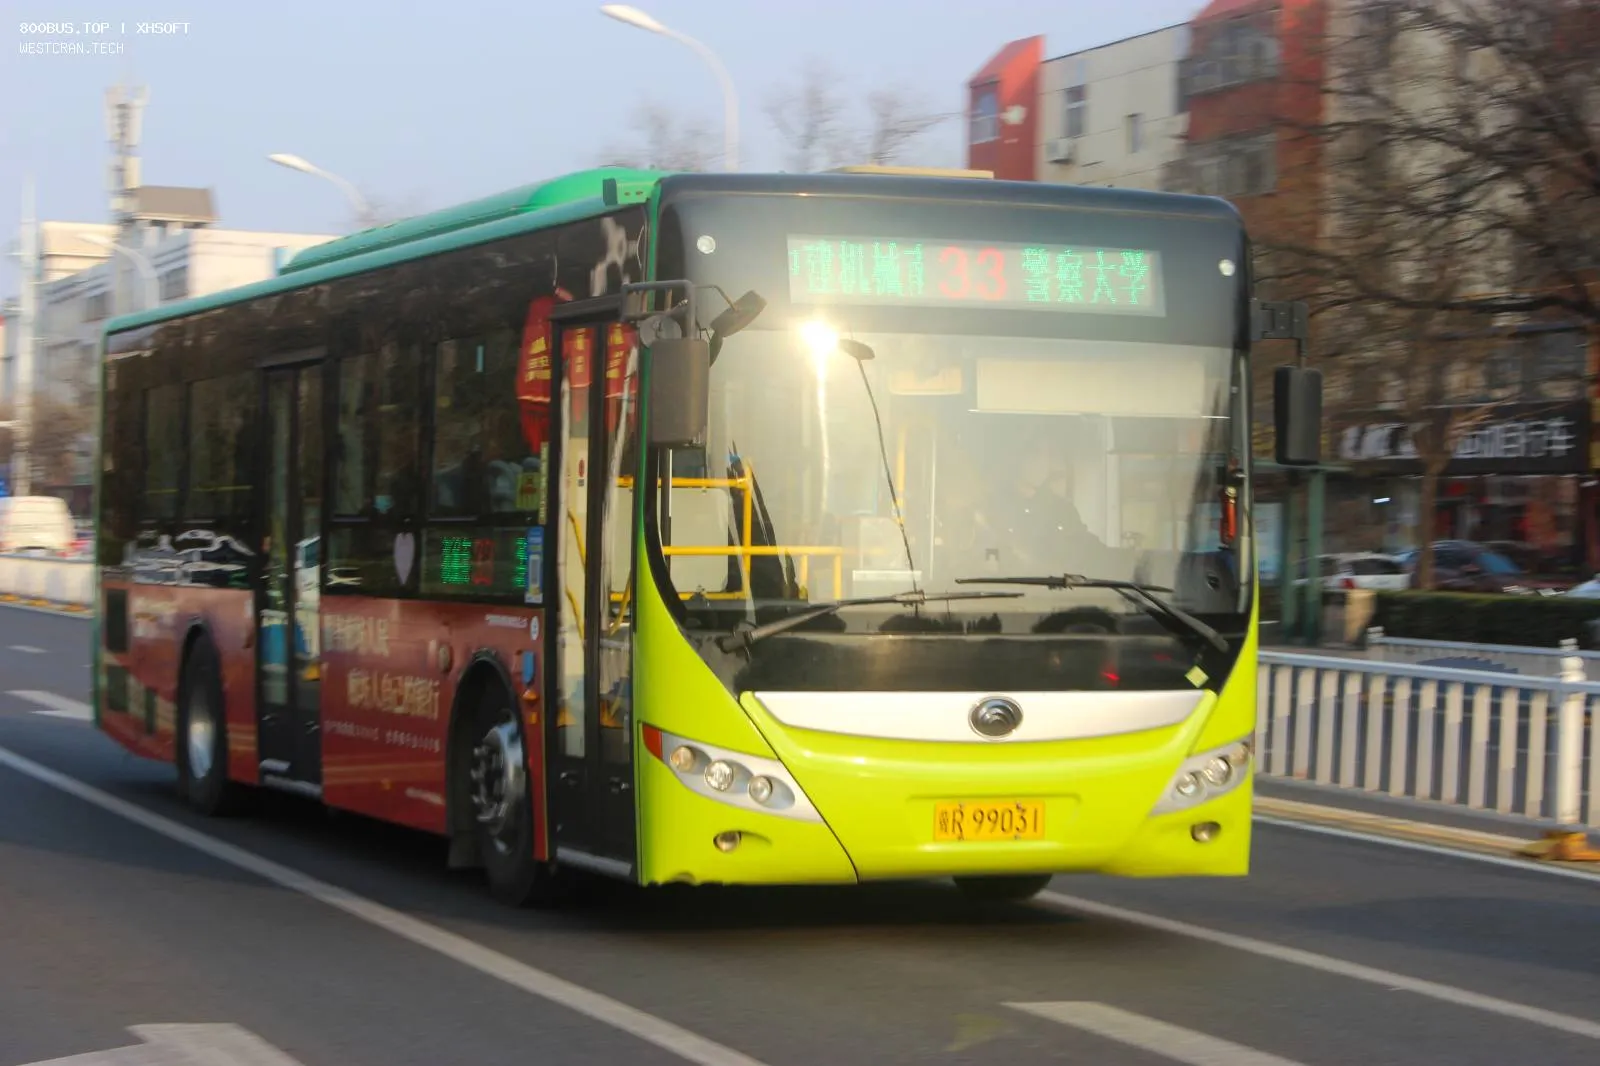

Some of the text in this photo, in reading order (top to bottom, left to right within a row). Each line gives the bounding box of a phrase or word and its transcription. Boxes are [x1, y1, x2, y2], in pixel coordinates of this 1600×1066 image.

[938, 246, 1008, 301] 33
[1021, 247, 1150, 305] 警察大学
[972, 806, 1038, 833] 99031
